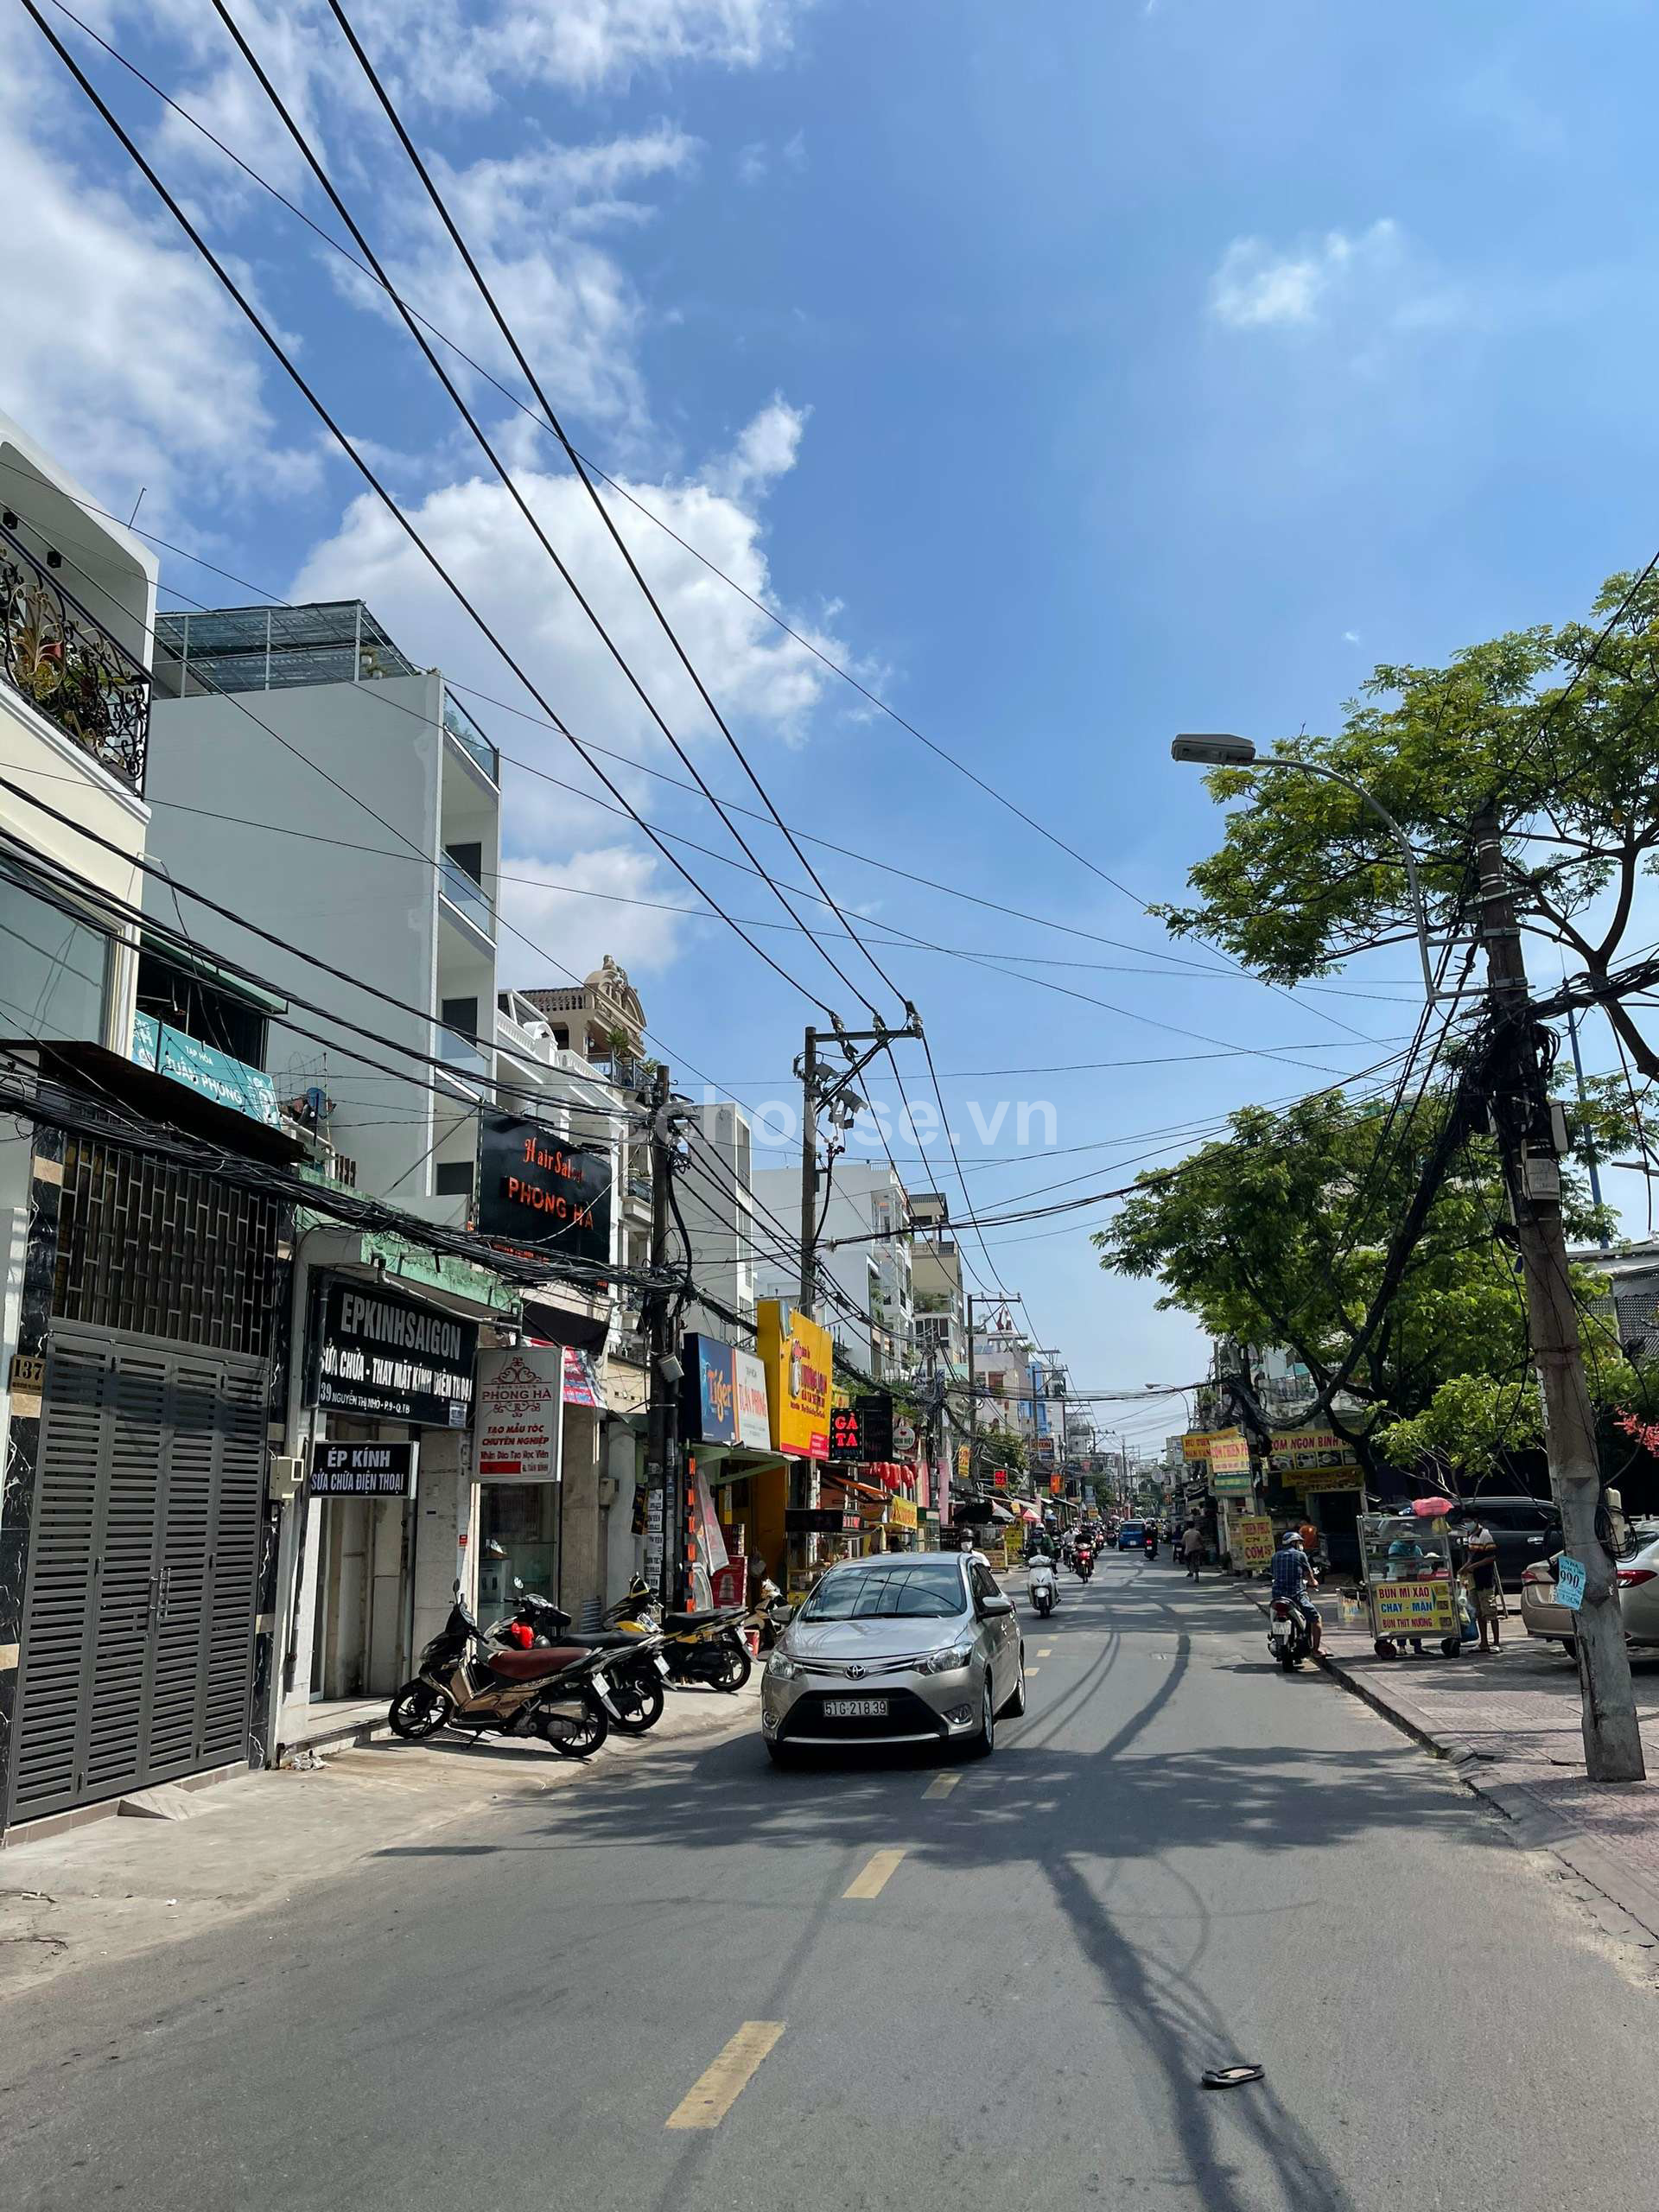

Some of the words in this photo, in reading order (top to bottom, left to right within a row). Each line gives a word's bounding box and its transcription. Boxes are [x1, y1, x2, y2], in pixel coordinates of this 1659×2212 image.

[201, 1073, 242, 1105] PHONG
[524, 1137, 553, 1170] Hair
[508, 1175, 566, 1218] PHONG
[340, 1293, 461, 1360] EPKINHSAIGON
[14, 1359, 43, 1381] 137
[340, 1346, 365, 1381] CHỮA
[372, 1357, 394, 1386] THAY
[393, 1359, 412, 1395] MẶT
[482, 1389, 529, 1400] PHONG
[533, 1388, 551, 1399] HÀ
[707, 1369, 733, 1423] Tiger
[527, 1423, 544, 1433] TÓC
[835, 1412, 859, 1430] GÀ
[517, 1434, 550, 1446] NGHIỆP
[835, 1433, 858, 1446] TA
[1291, 1437, 1315, 1450] NGON
[327, 1446, 347, 1467] ÉP
[352, 1446, 391, 1467] KÍNH
[311, 1467, 328, 1491] SỬA
[331, 1471, 353, 1491] CHỮA
[356, 1470, 377, 1494] ĐIỆN
[379, 1473, 404, 1494] THOẠI
[1560, 1570, 1580, 1588] 990
[1381, 1603, 1402, 1612] CHAY
